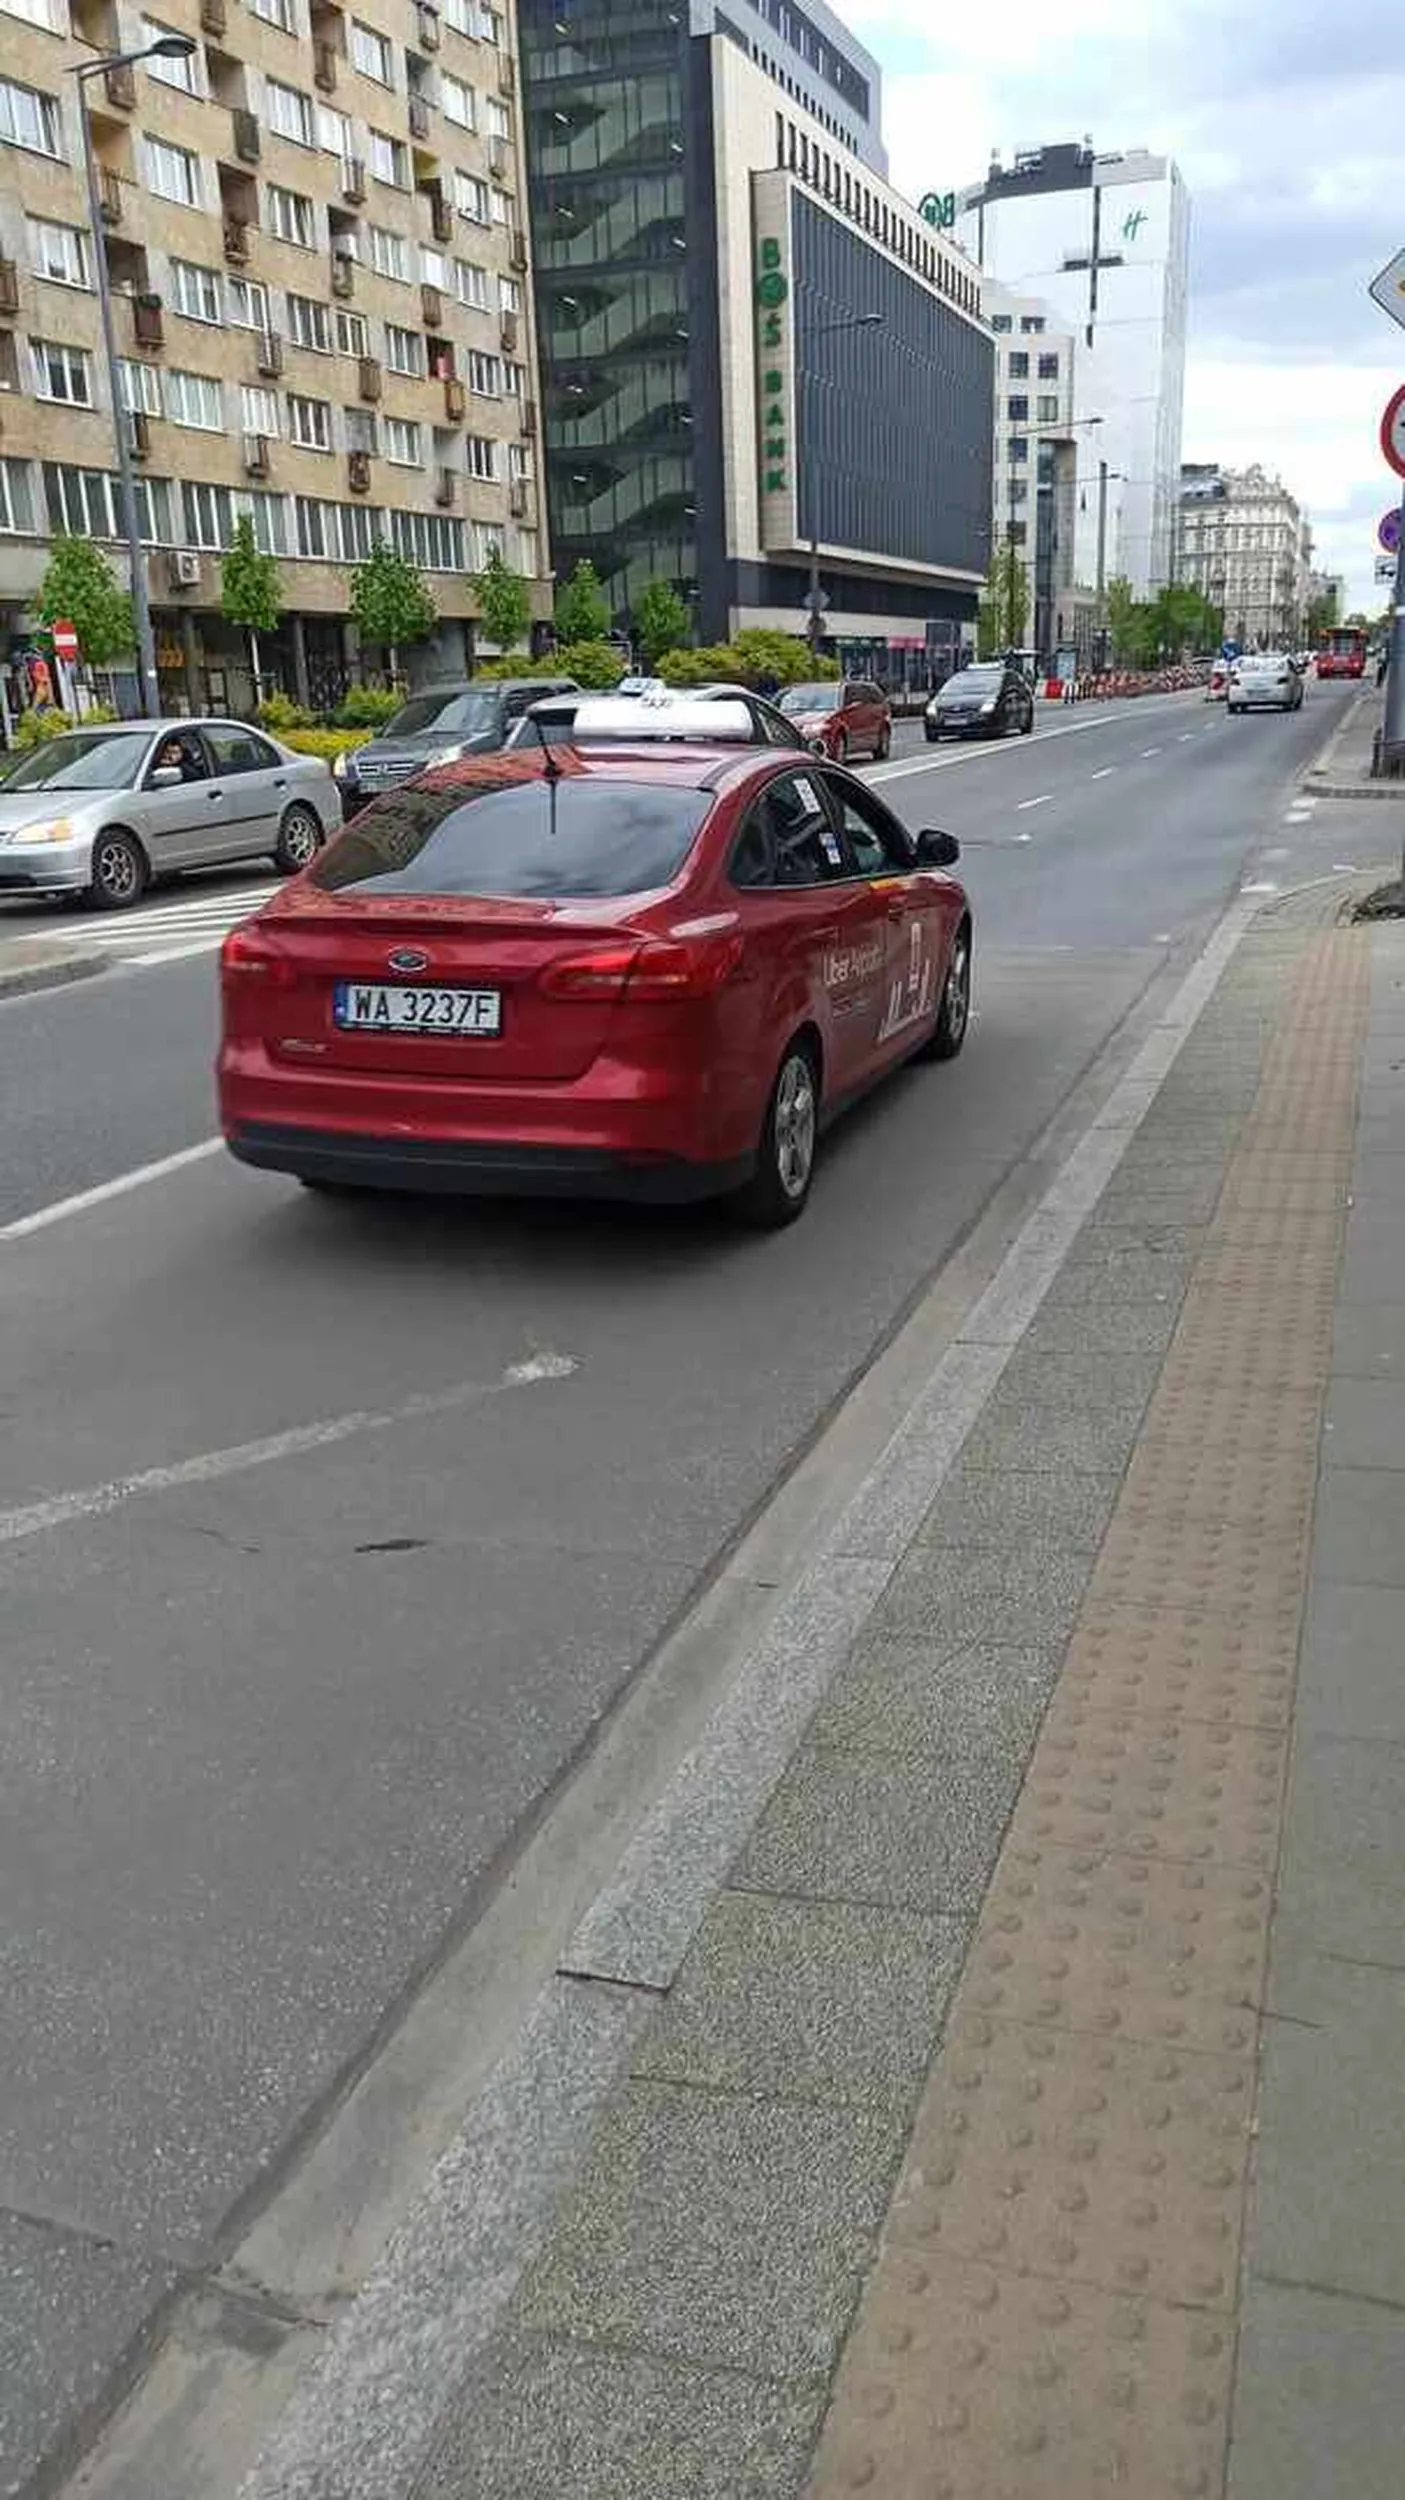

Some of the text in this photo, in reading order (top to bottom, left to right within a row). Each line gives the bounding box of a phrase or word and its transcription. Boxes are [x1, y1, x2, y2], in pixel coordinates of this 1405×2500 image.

[765, 369, 787, 491] BANK
[355, 988, 495, 1025] WA 3237F
